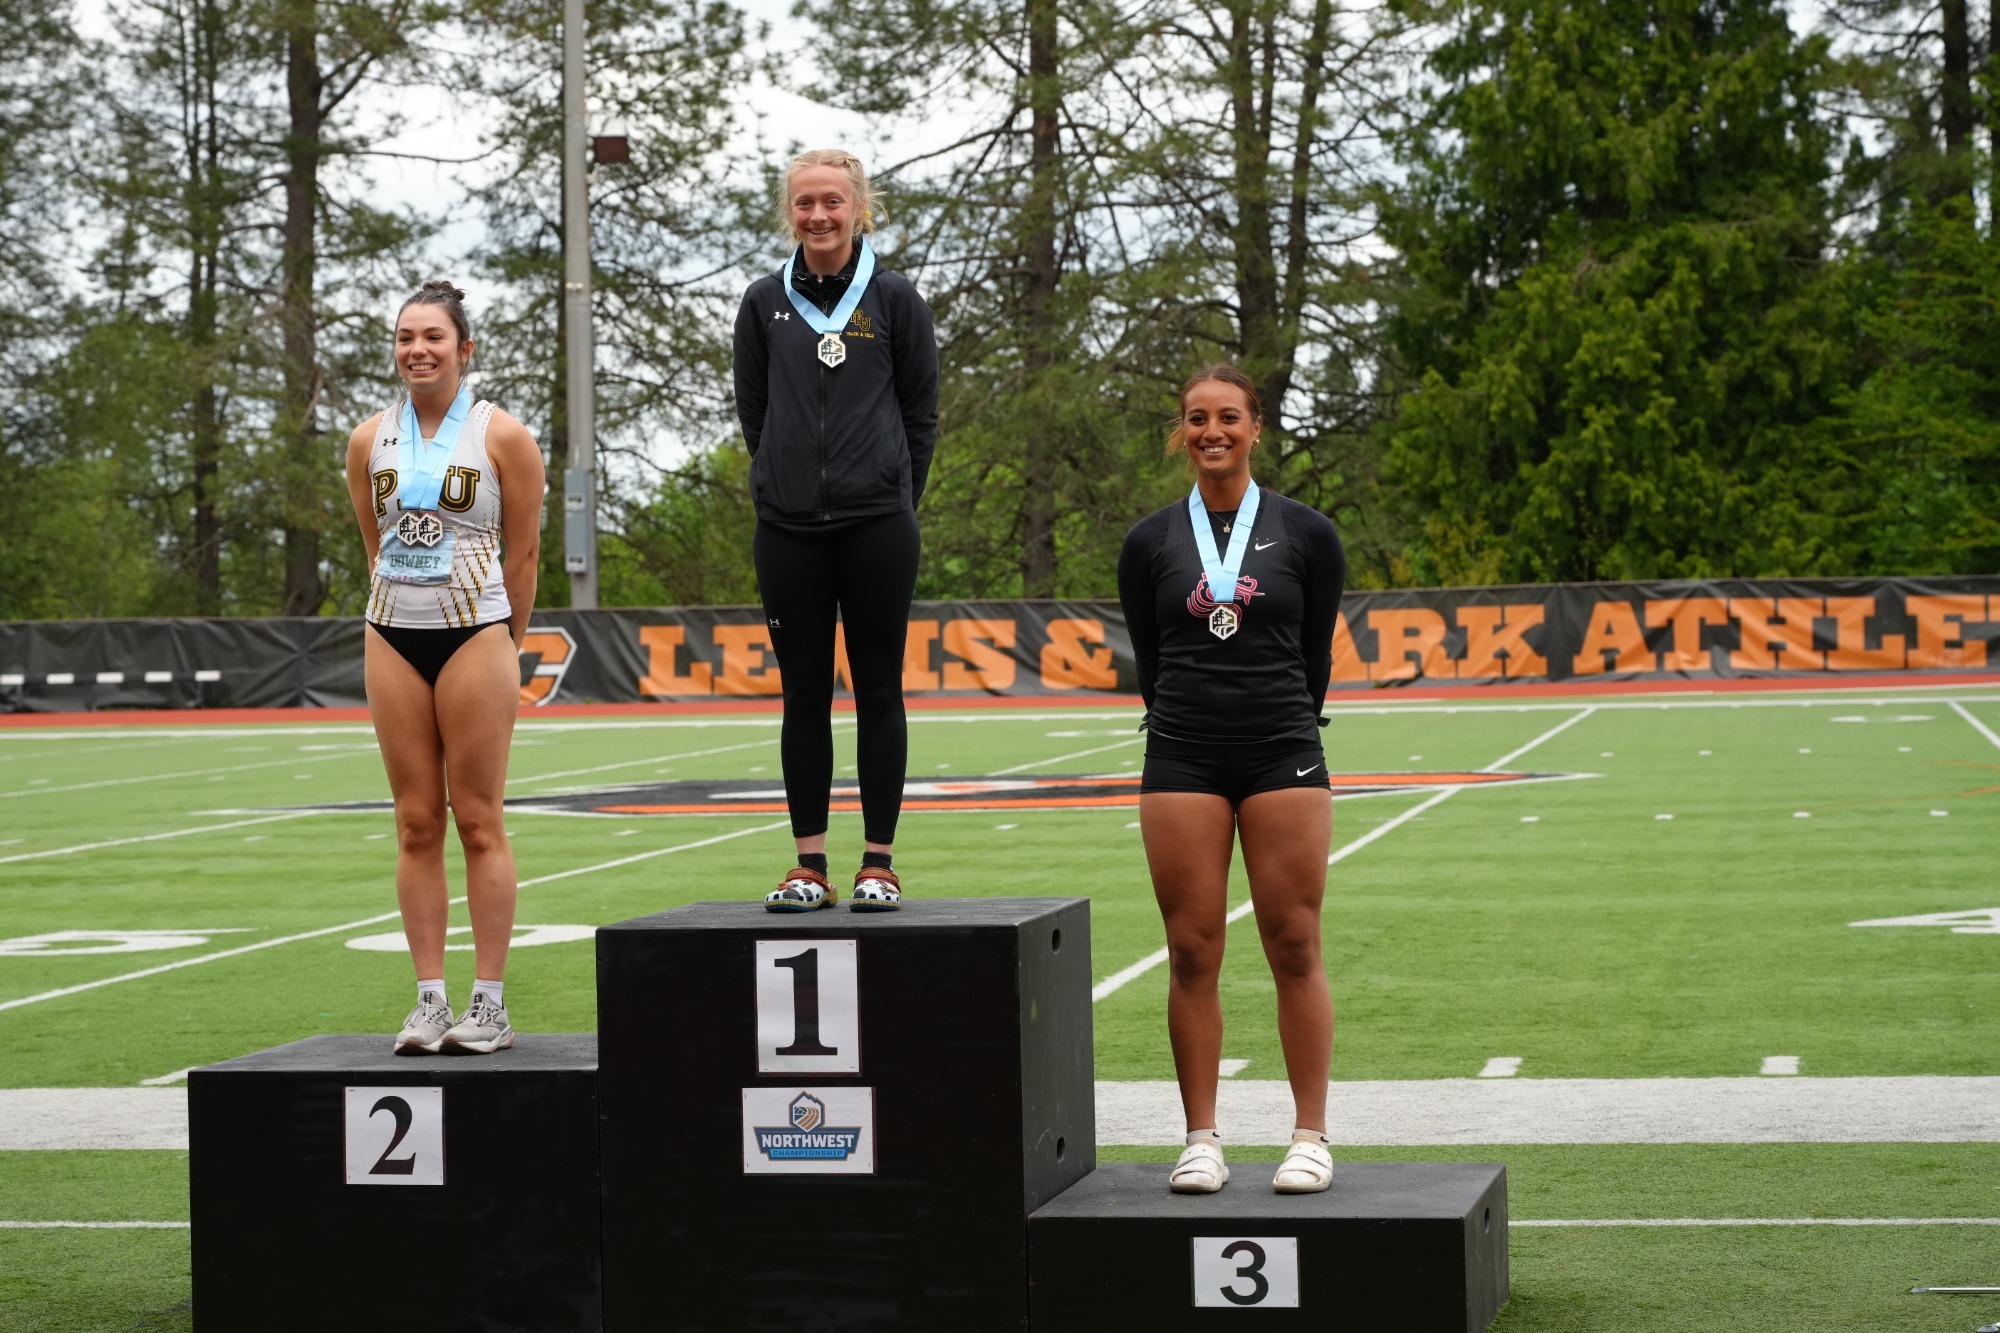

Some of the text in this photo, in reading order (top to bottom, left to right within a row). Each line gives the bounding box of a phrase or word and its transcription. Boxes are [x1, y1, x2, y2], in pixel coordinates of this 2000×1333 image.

[373, 465, 481, 518] PU
[389, 554, 441, 569] DOWNEY
[639, 618, 1016, 695] LEIS
[1040, 618, 1118, 690] &
[1572, 594, 2000, 675] ATHLE
[774, 947, 838, 1056] 1
[368, 1095, 416, 1175] 2
[761, 1134, 855, 1148] NORTHWEST
[1220, 1240, 1269, 1306] 3
